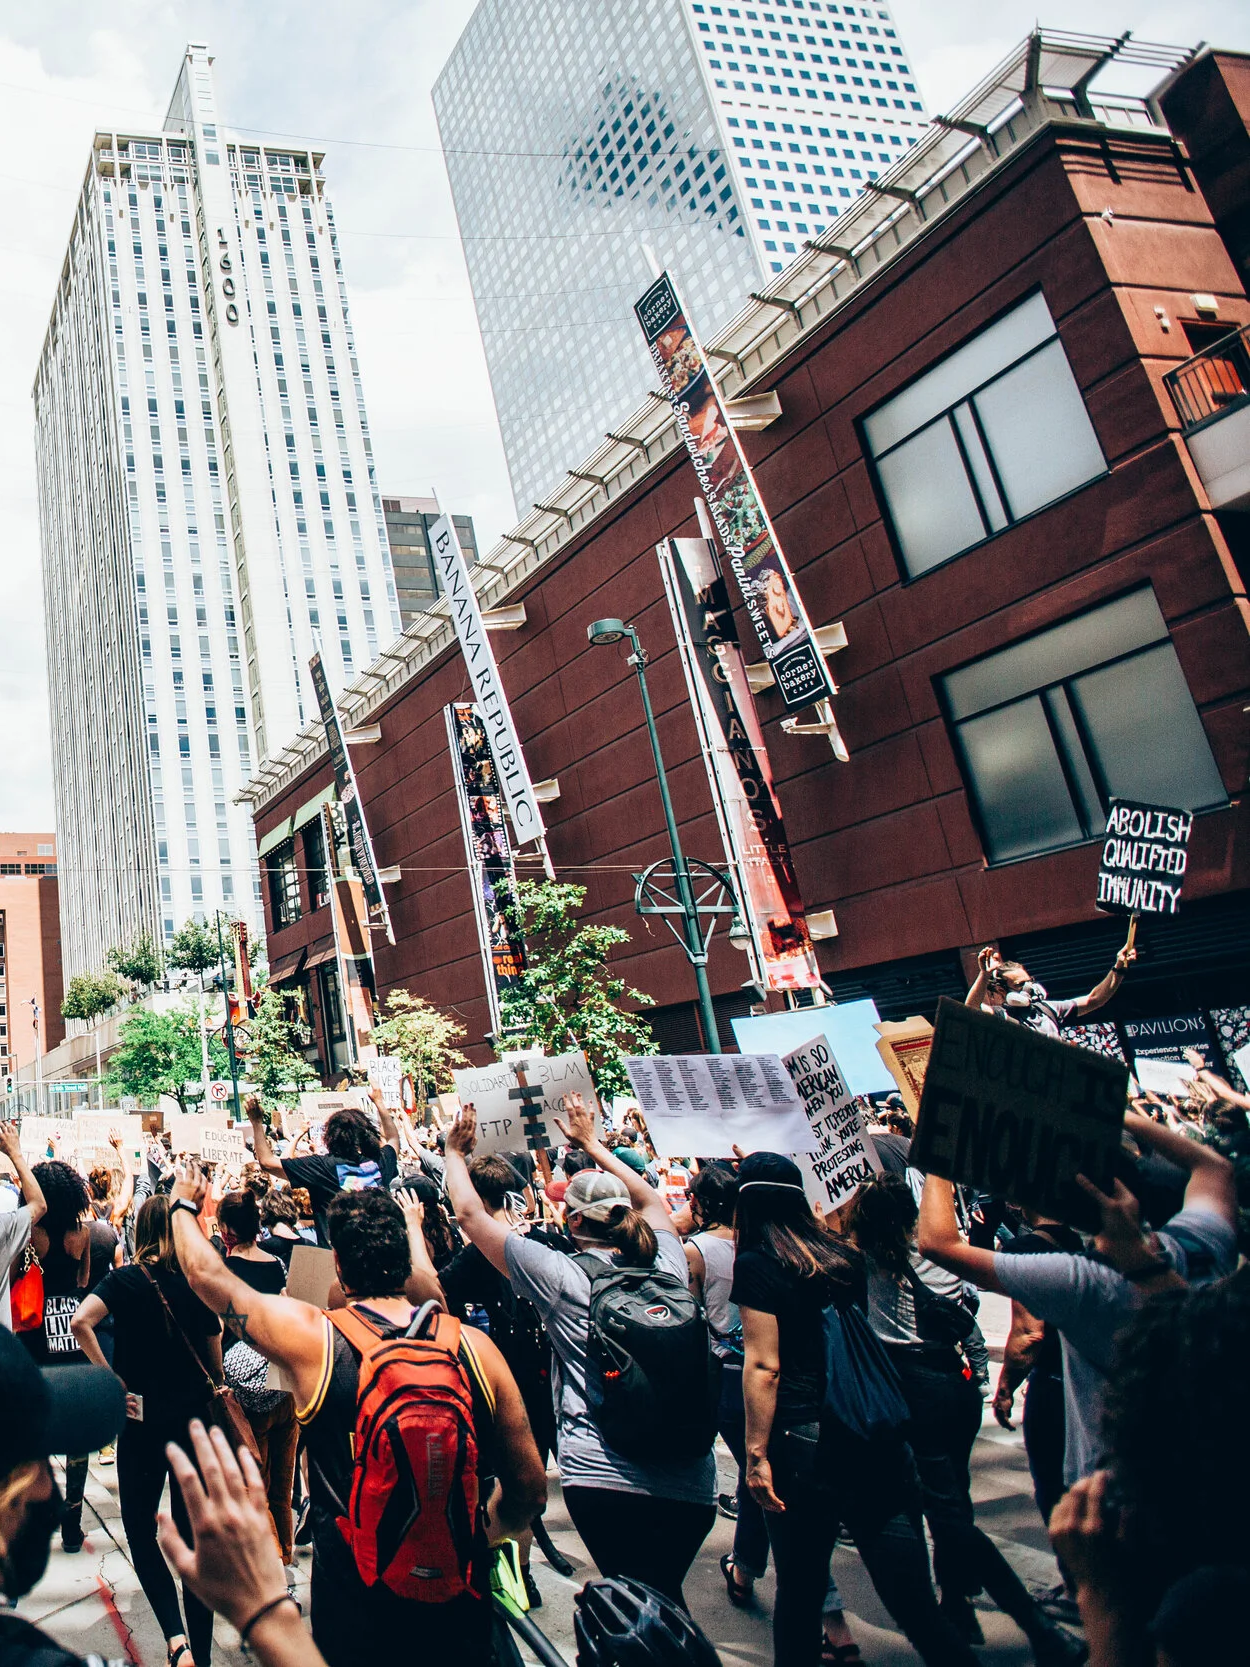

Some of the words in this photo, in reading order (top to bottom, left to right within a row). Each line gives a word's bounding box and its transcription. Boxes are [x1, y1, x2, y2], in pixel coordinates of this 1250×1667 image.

[217, 228, 239, 325] 1600
[643, 290, 670, 321] corner
[645, 298, 672, 328] bakery
[650, 341, 679, 405] BREAKFAST
[673, 401, 714, 494] Sandwiches
[707, 490, 733, 546] SALADS
[726, 542, 754, 602] Panini
[747, 599, 775, 660] SWEETS
[435, 530, 482, 663] BANANA
[475, 667, 534, 828] REPUBLIC
[780, 659, 814, 682] corner
[783, 668, 817, 690] bakery
[792, 680, 815, 694] CAFE
[694, 586, 768, 833] MAGGIANO'S
[1106, 805, 1192, 843] ABOLISH
[742, 845, 787, 854] LITTLE
[1103, 838, 1187, 875] QUALIFIED
[1096, 872, 1182, 914] IMMUNITY
[1130, 1016, 1206, 1037] PAVILIONS
[797, 1055, 811, 1074] IS
[810, 1044, 829, 1068] SO
[1134, 1044, 1179, 1056] Experience
[369, 1060, 400, 1074] BLACK
[461, 1072, 518, 1097] SOLIDARITY
[825, 1082, 844, 1106] YOU
[1070, 1060, 1127, 1124] IS
[831, 1098, 859, 1127] PEOPLE
[205, 1131, 242, 1145] EDUCATE
[480, 1118, 513, 1139] FTP
[202, 1147, 244, 1164] LIBERATE
[812, 1138, 865, 1182] PROTESTING
[824, 1157, 875, 1204] AMERICA
[46, 1297, 81, 1315] BLACK
[46, 1316, 73, 1336] LIV
